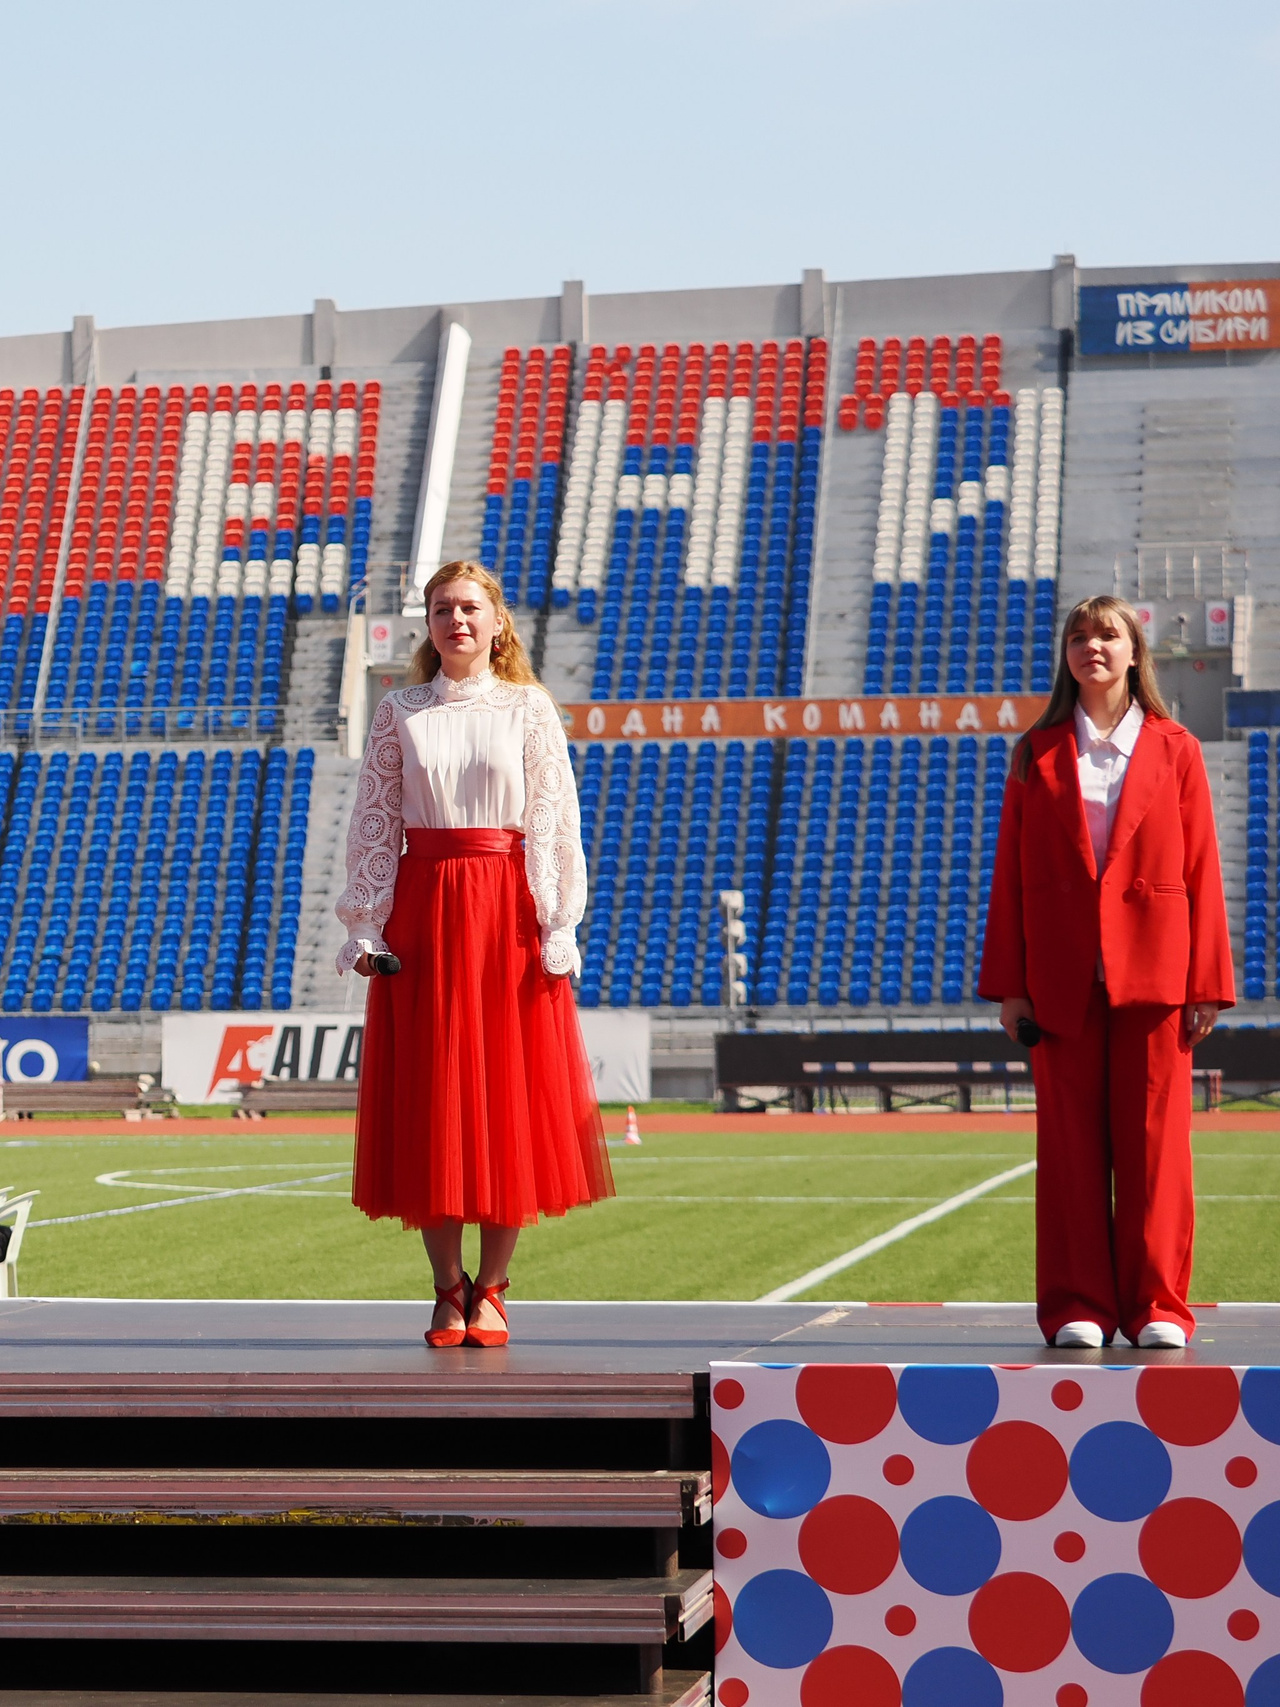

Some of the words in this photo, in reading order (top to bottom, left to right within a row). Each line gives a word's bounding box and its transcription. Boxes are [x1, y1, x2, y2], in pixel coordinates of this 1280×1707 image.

[1116, 287, 1268, 318] ПРЯМИКОМ
[1114, 319, 1156, 346] ИЗ
[1158, 316, 1269, 345] СИБИРИ
[586, 703, 720, 738] ОДНА
[762, 698, 1019, 733] КОМАНДА
[271, 1025, 364, 1080] АГА
